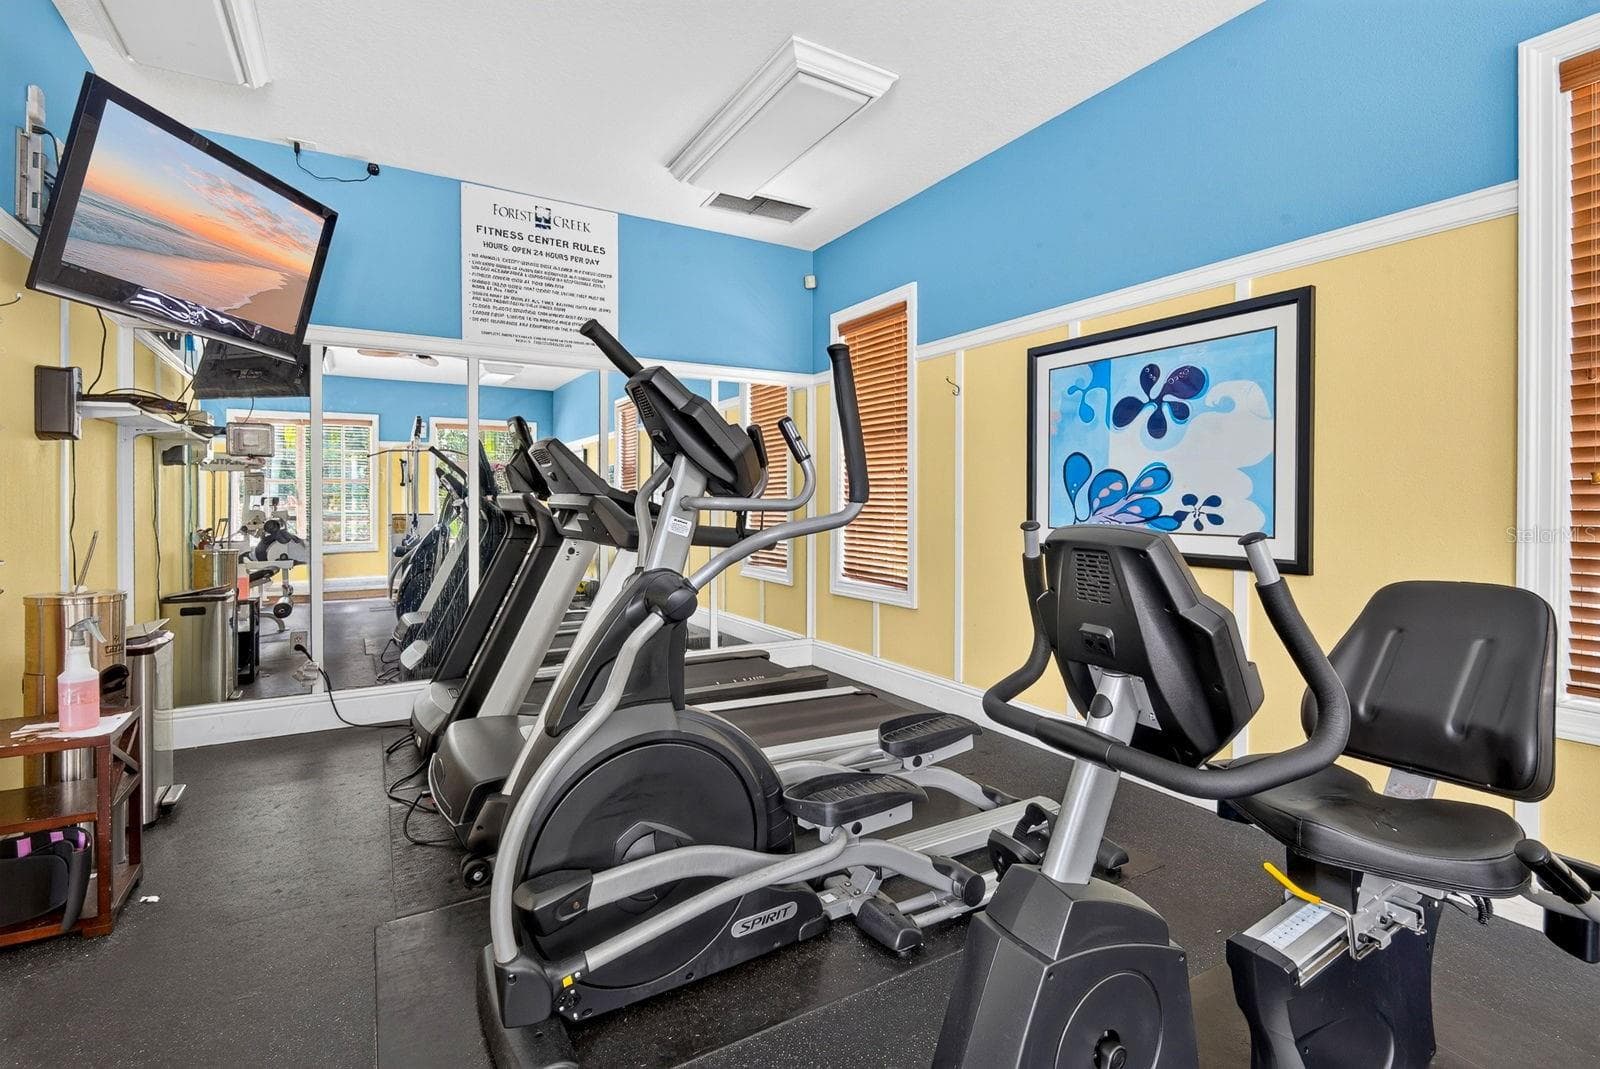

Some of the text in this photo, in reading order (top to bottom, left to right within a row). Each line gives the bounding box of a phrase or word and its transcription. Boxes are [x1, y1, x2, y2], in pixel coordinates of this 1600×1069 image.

[493, 203, 591, 233] FOREST CREEK
[476, 225, 606, 256] FITNESS CENTER RULES
[512, 246, 531, 255] OPEN
[534, 249, 543, 257] 24
[545, 251, 568, 261] HOURS
[570, 255, 584, 264] PER
[585, 258, 599, 266] DAY
[738, 905, 792, 934] SPIRIT
